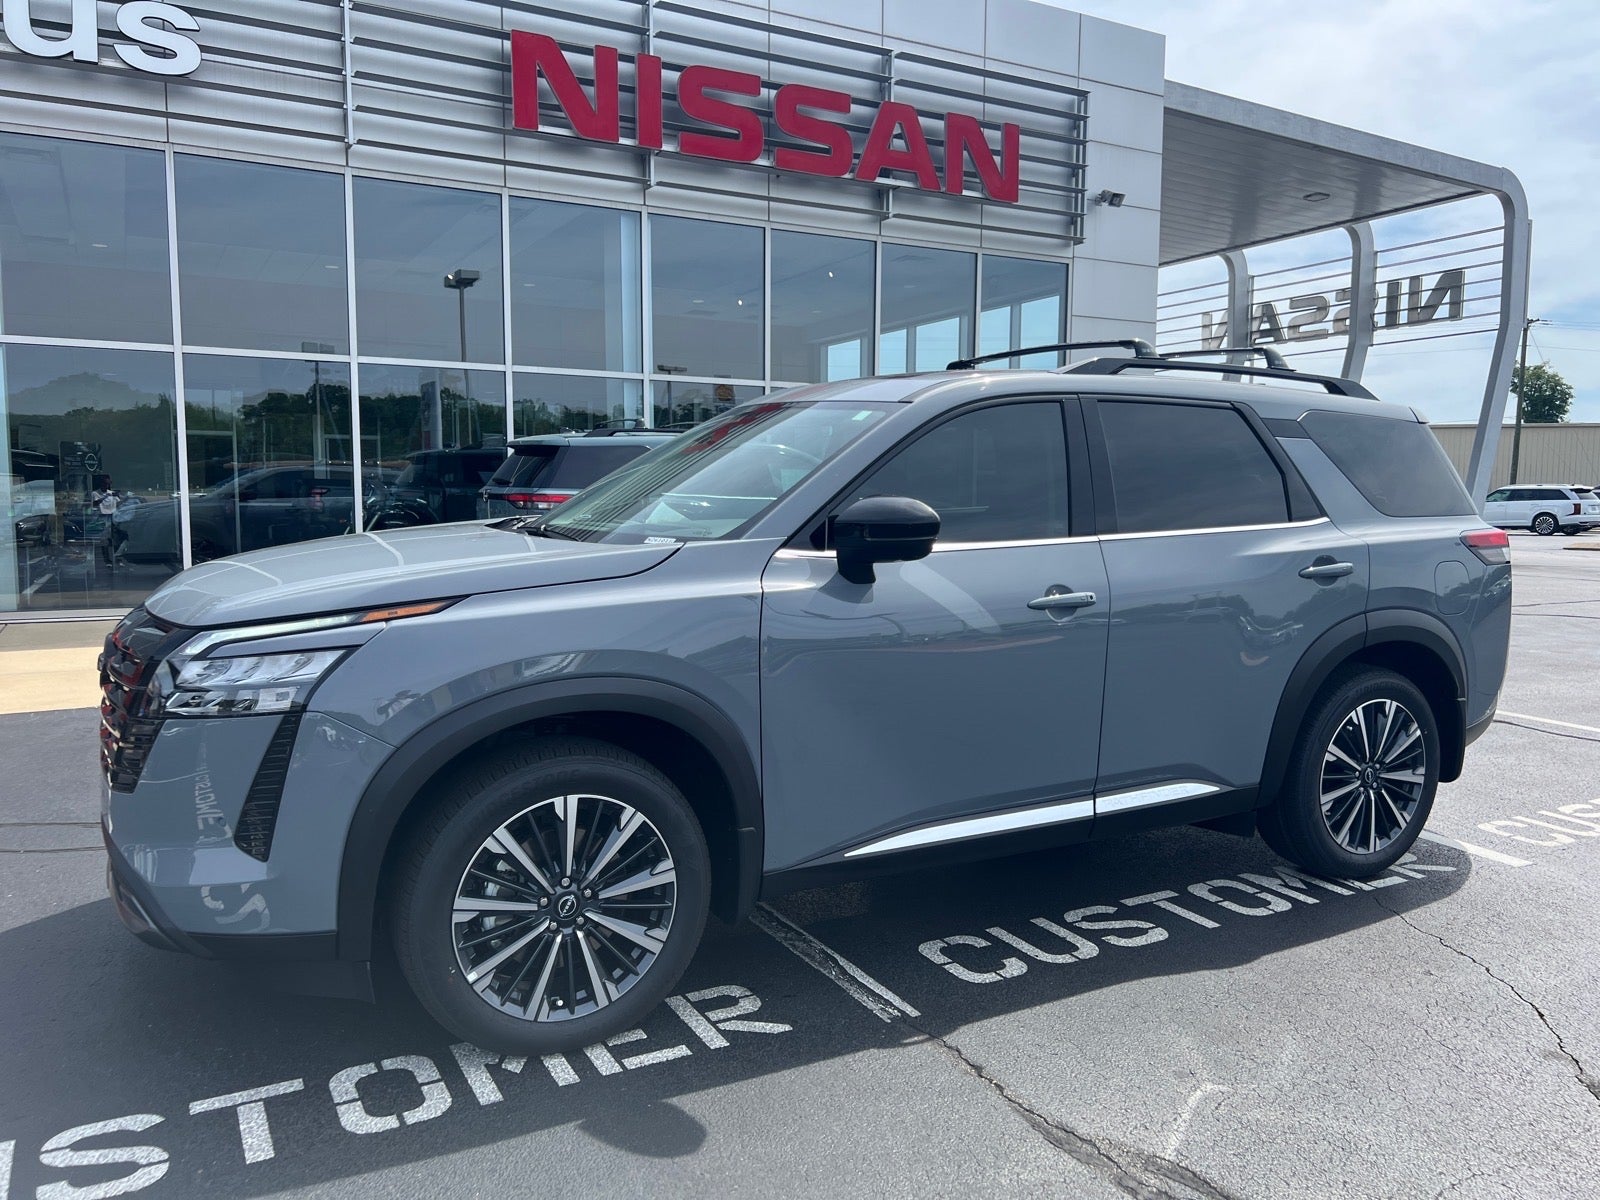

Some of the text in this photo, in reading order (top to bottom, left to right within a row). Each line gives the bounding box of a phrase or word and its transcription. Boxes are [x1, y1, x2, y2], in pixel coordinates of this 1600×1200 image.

[3, 0, 202, 76] us
[511, 30, 1020, 203] NISSAN
[0, 984, 793, 1200] STOMER
